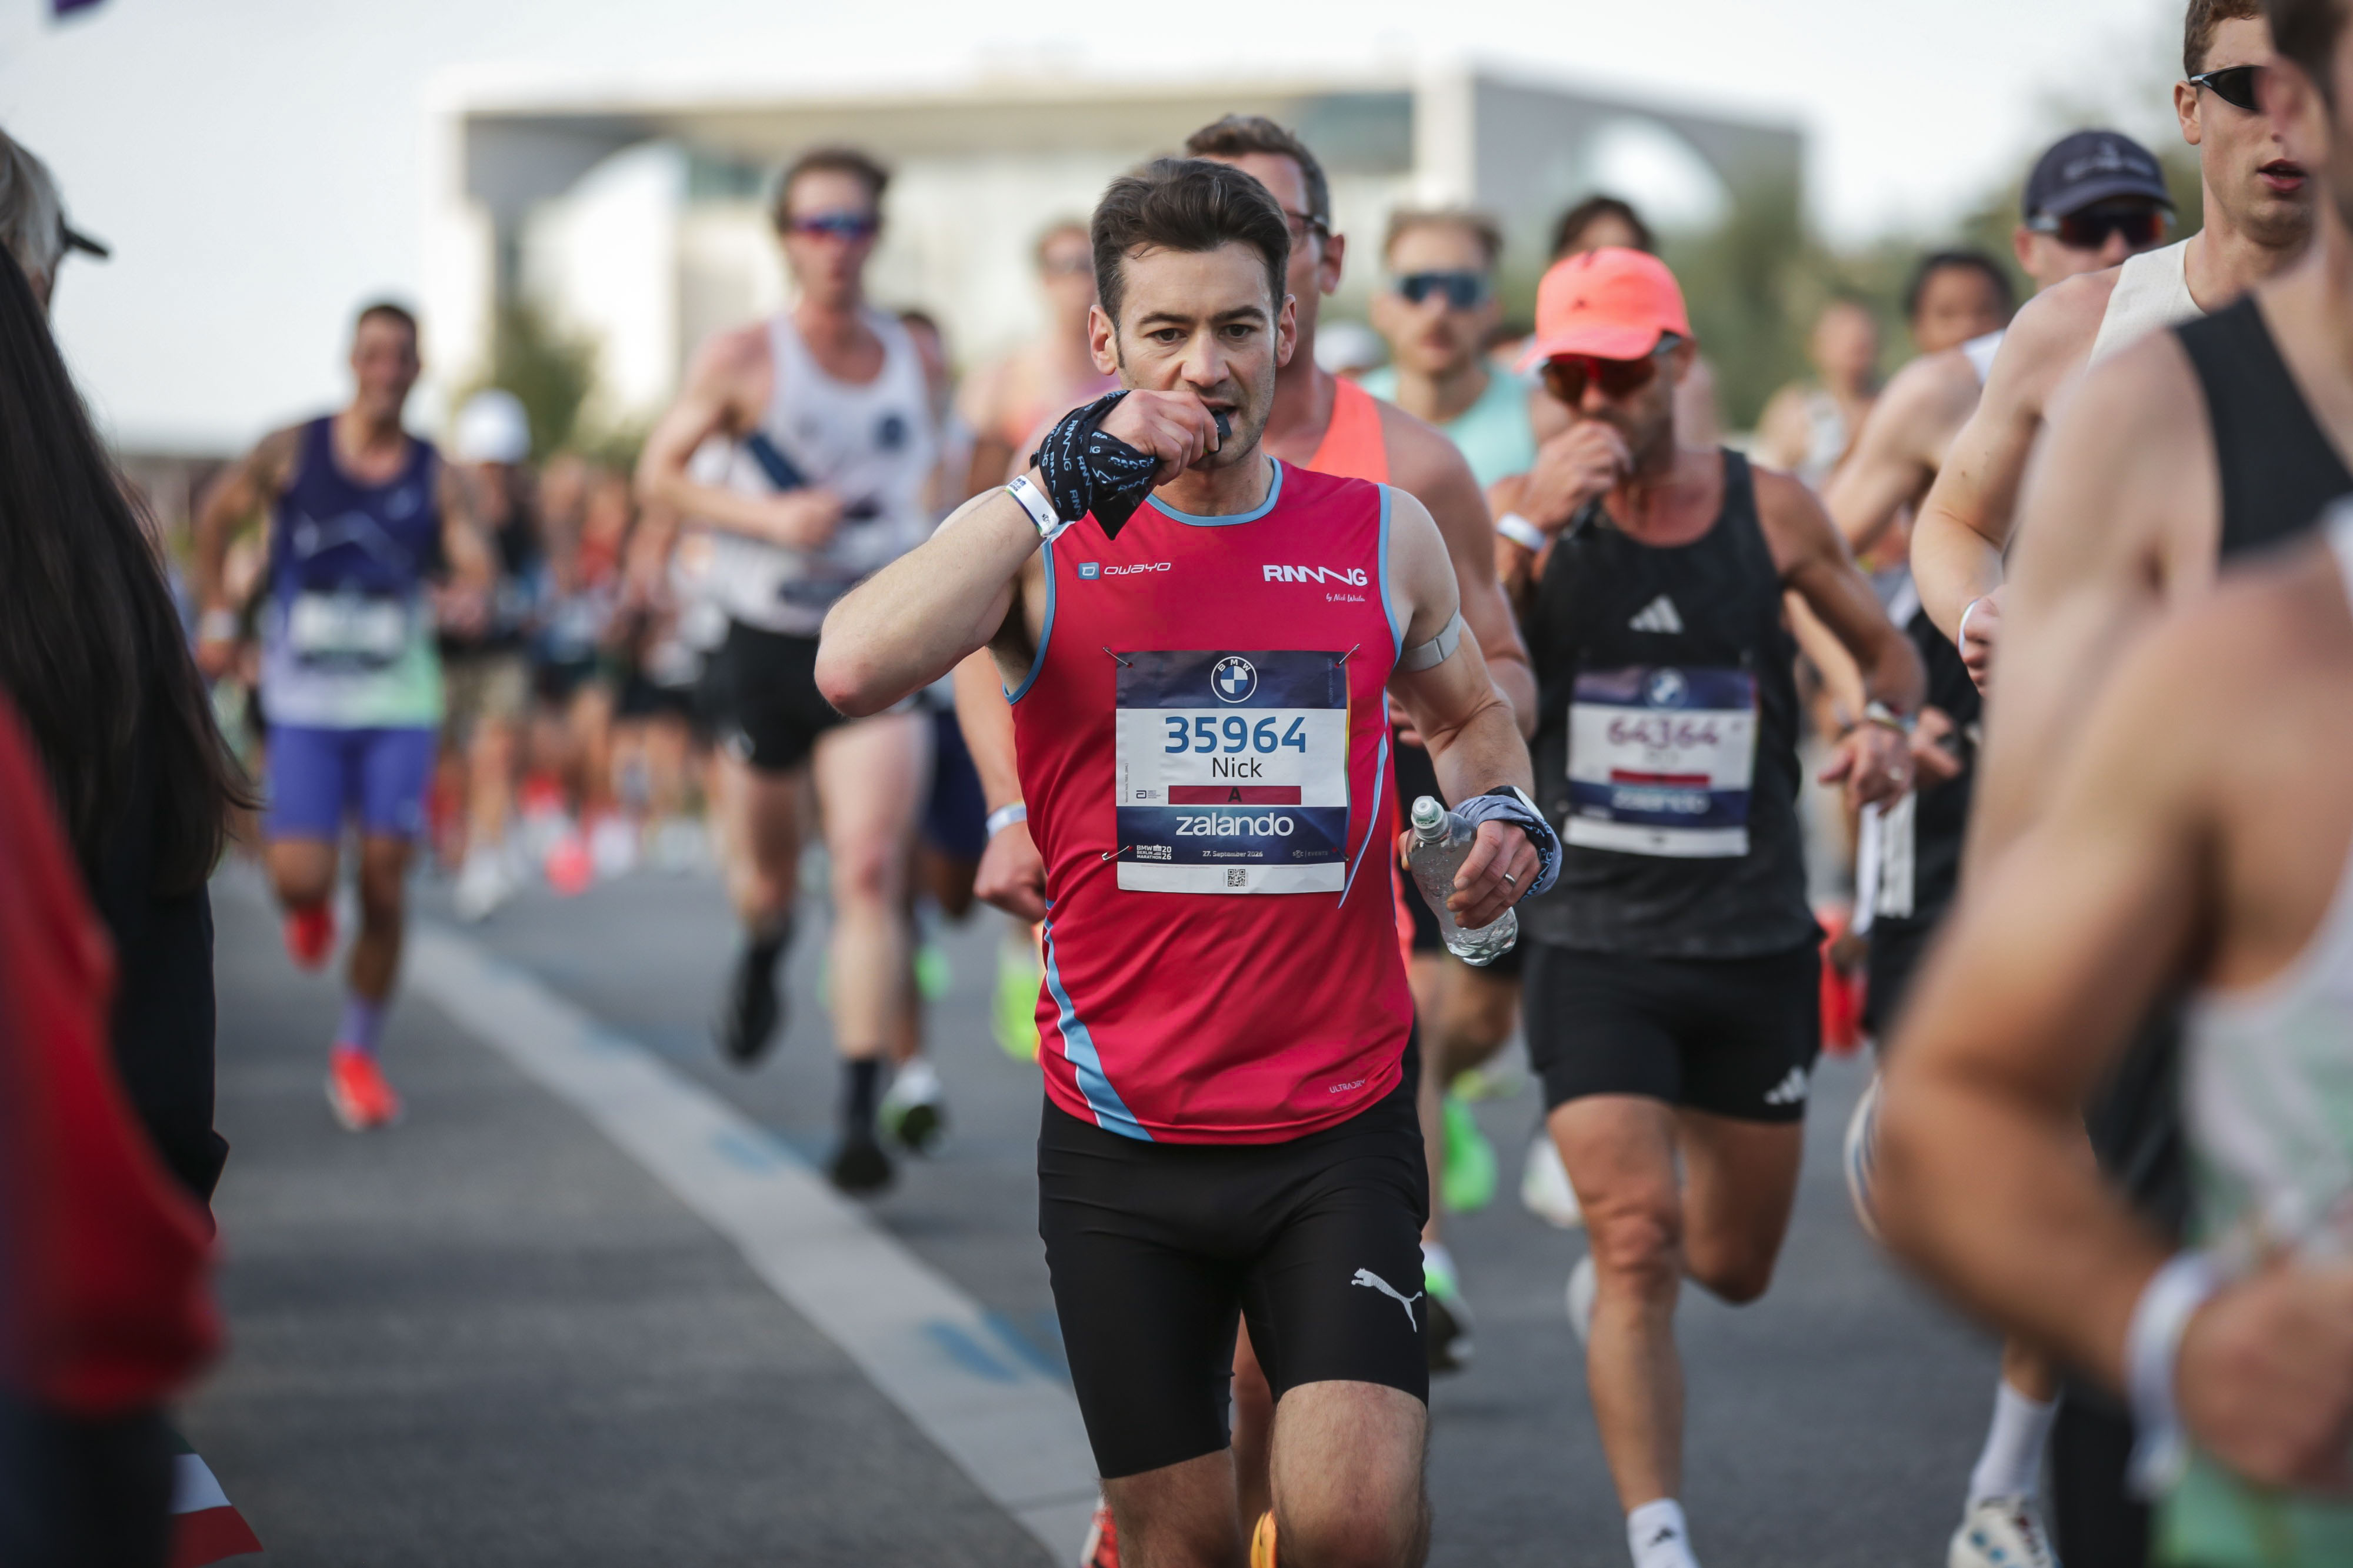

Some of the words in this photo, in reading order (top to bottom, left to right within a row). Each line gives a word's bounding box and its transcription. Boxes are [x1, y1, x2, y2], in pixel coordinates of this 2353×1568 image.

[1104, 562, 1171, 575] owayo
[1326, 593, 1332, 602] by
[1334, 593, 1347, 602] Nick
[1218, 659, 1251, 672] BMW
[1165, 716, 1306, 753] 35964
[1212, 757, 1263, 778] Nick
[1228, 786, 1242, 803] A
[1176, 812, 1295, 836] zalando
